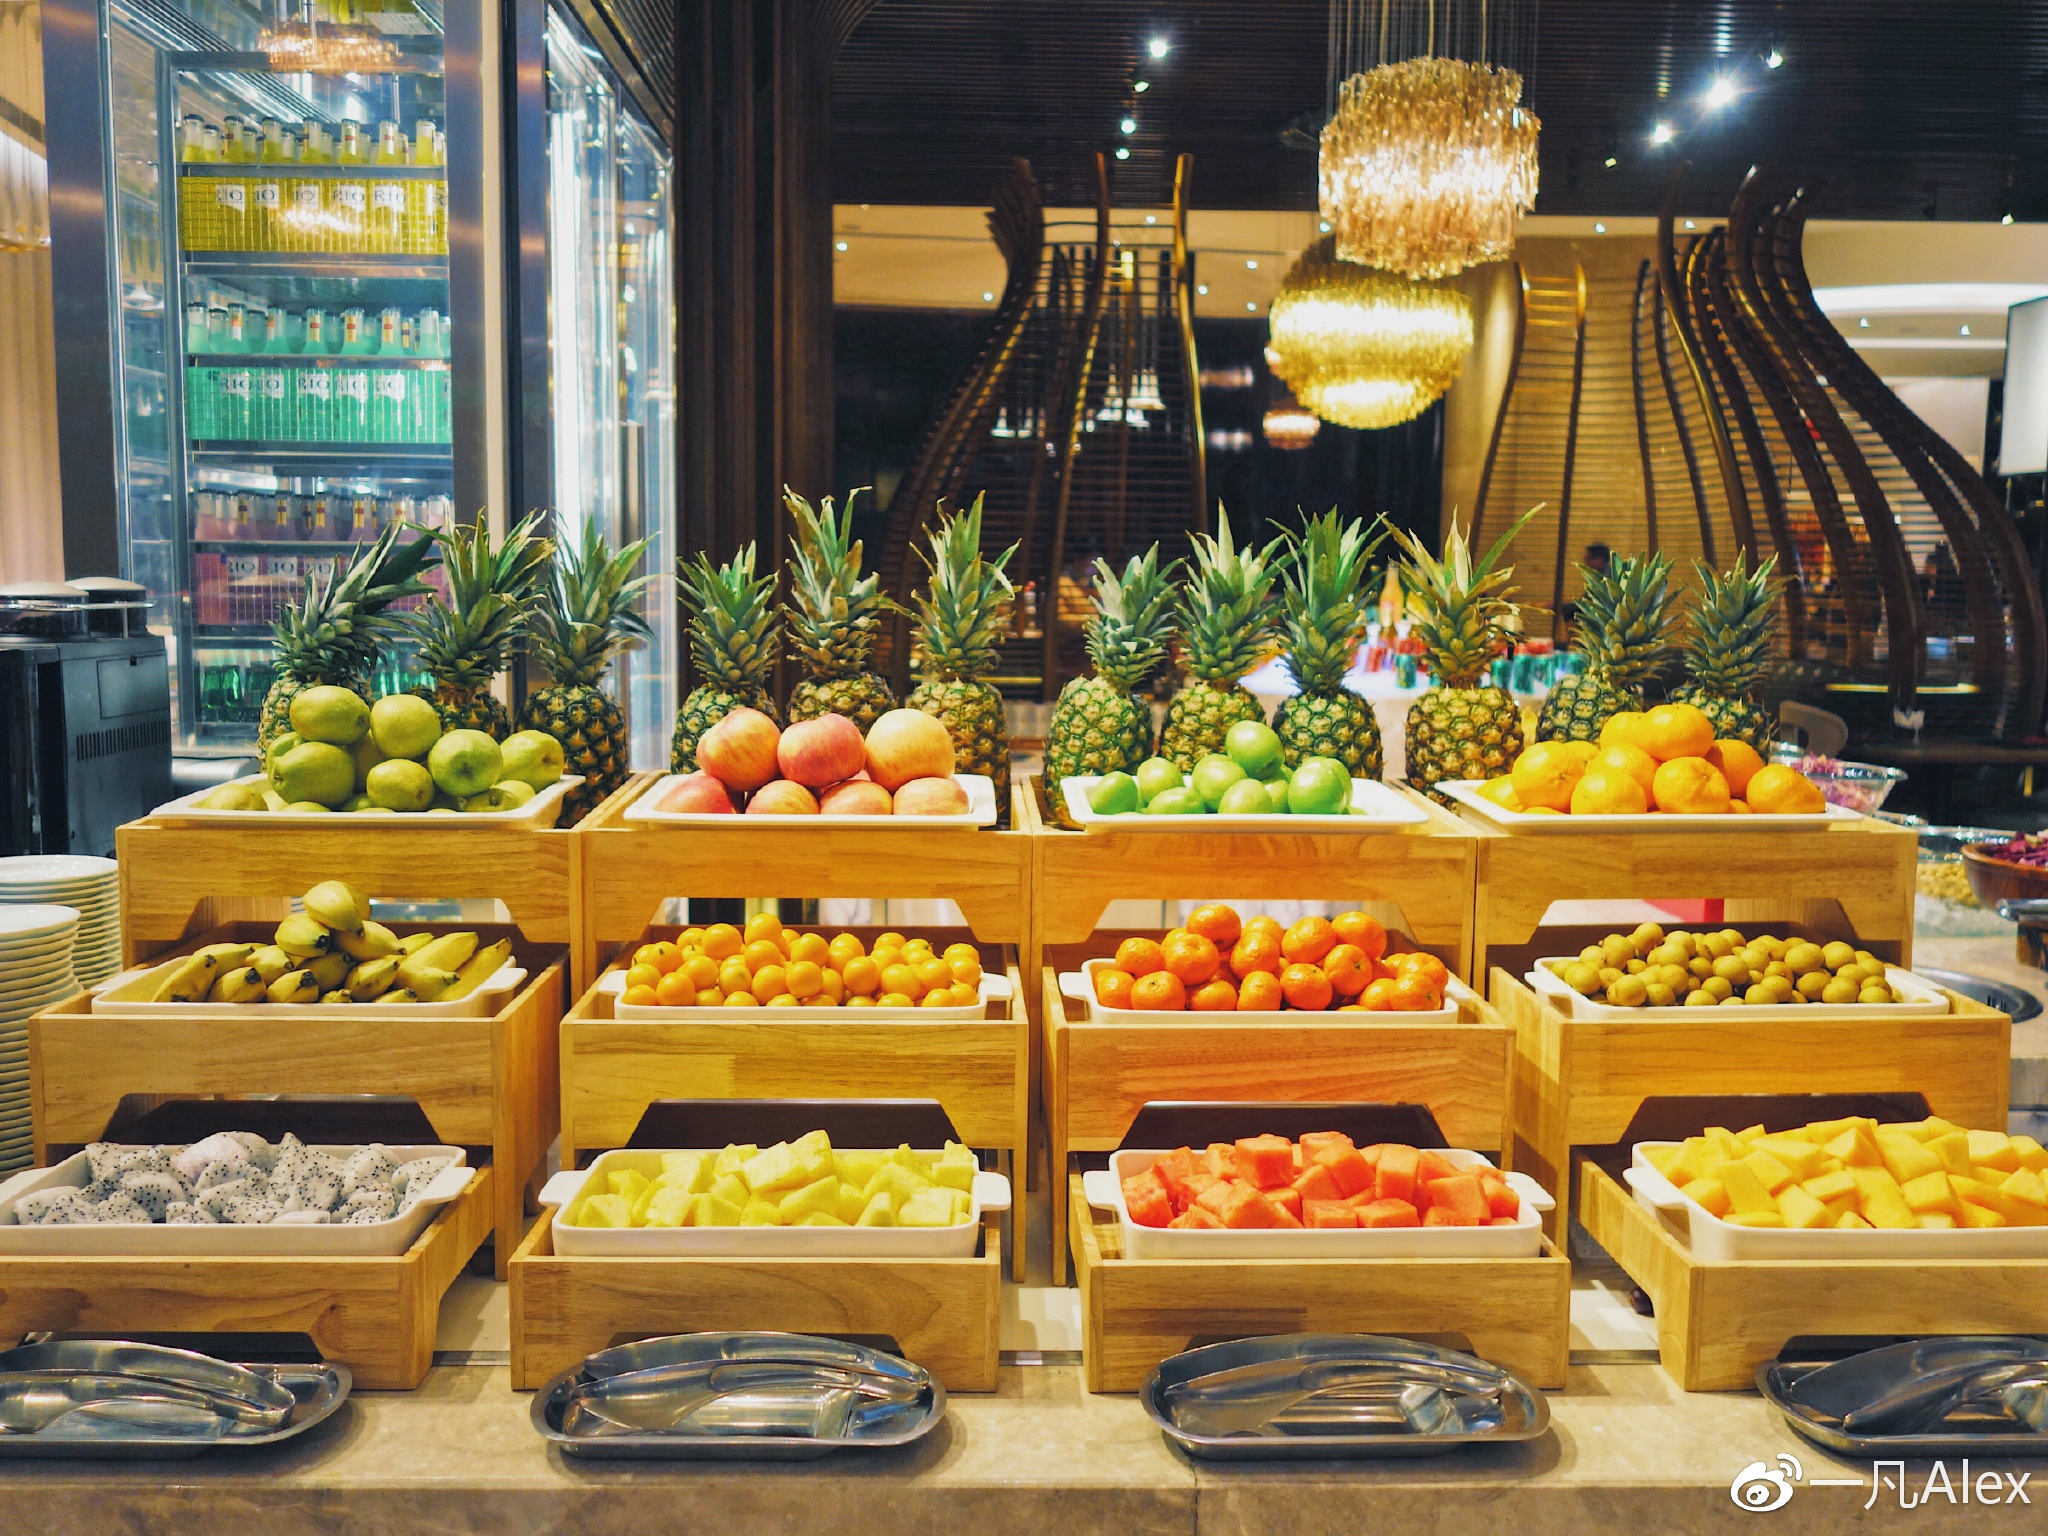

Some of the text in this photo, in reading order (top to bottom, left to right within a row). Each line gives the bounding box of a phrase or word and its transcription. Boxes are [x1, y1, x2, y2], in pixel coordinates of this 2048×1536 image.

[374, 190, 406, 204] RIO
[220, 377, 252, 390] RIO
[298, 377, 330, 390] RIO
